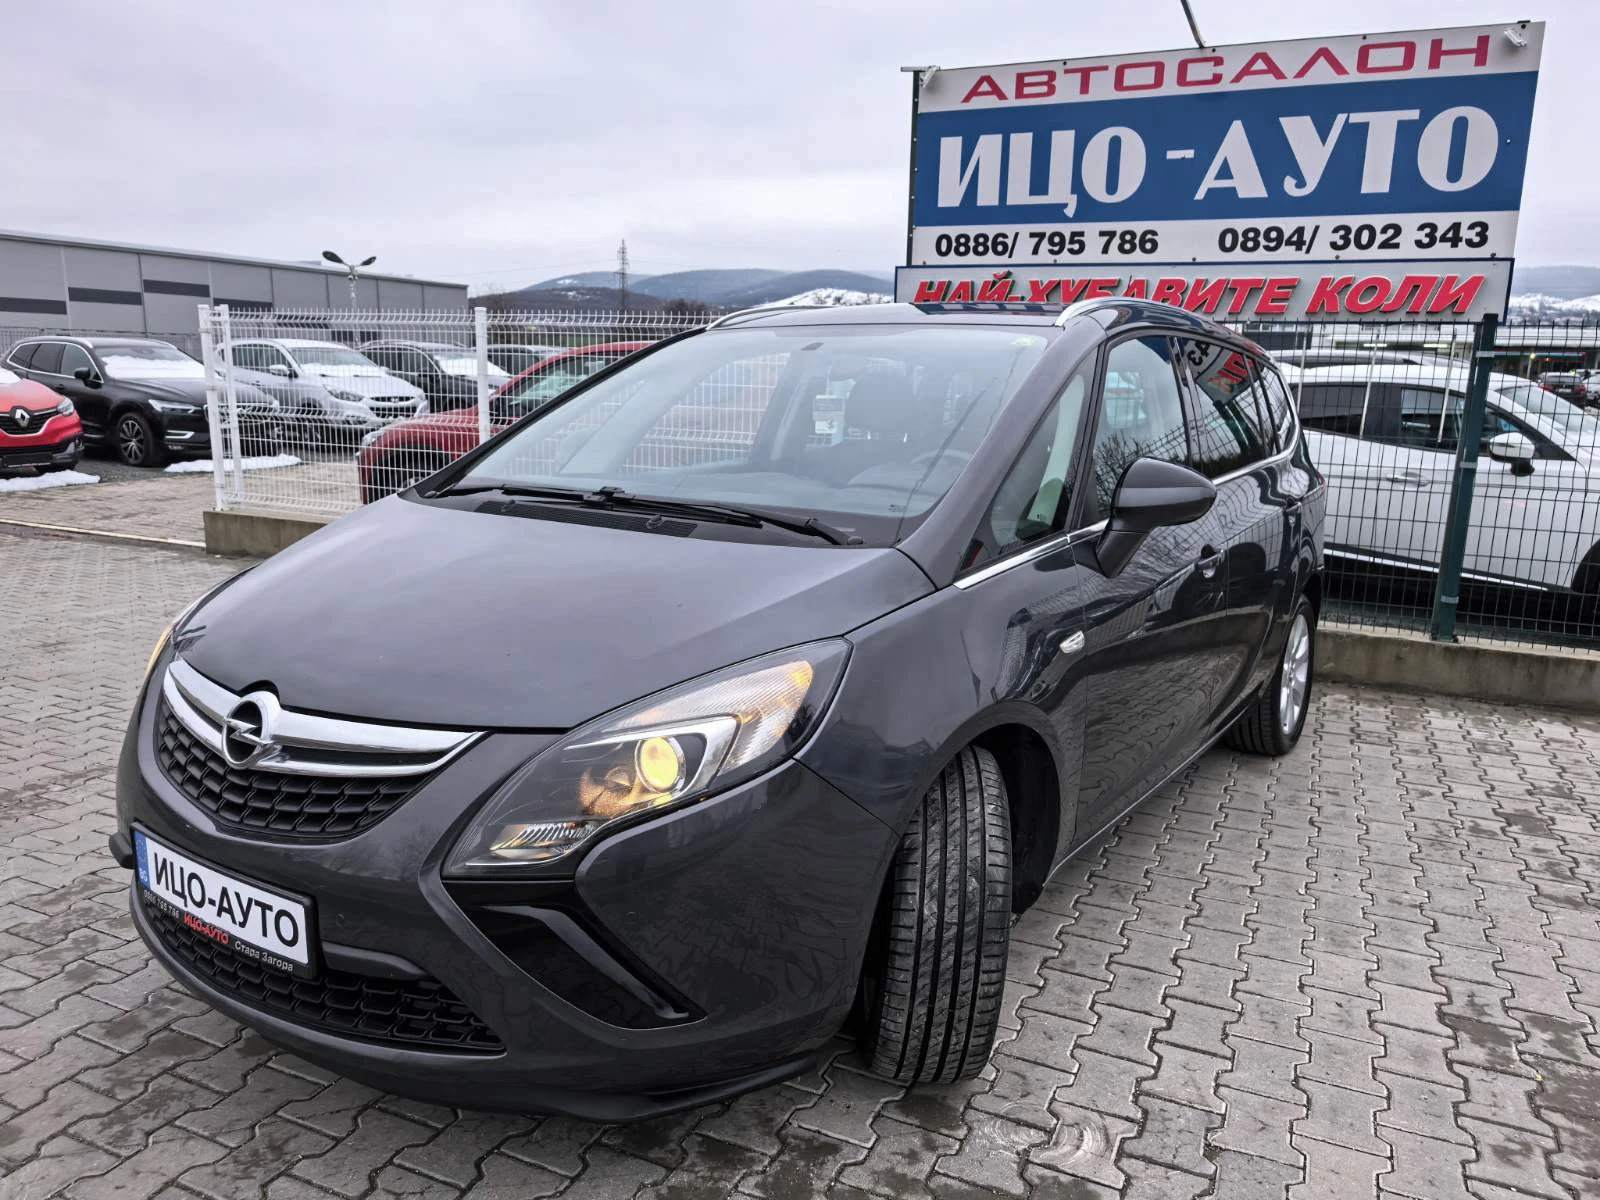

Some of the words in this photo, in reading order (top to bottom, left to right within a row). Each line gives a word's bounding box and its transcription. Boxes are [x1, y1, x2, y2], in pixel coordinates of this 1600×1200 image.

[961, 35, 1490, 103] АВТОСАЛОН
[935, 232, 1019, 258] 0886/
[1028, 231, 1086, 255] 795
[1098, 229, 1159, 254] 786
[1218, 225, 1320, 254] 0894/
[1329, 223, 1402, 250] 302
[1414, 221, 1489, 249] 343
[1305, 275, 1485, 314] КОЛИ
[153, 852, 299, 948] ИЦО-АУТО
[183, 911, 229, 945] ИЦО-АУТО
[234, 941, 260, 959] Стара
[262, 952, 293, 972] Загора
